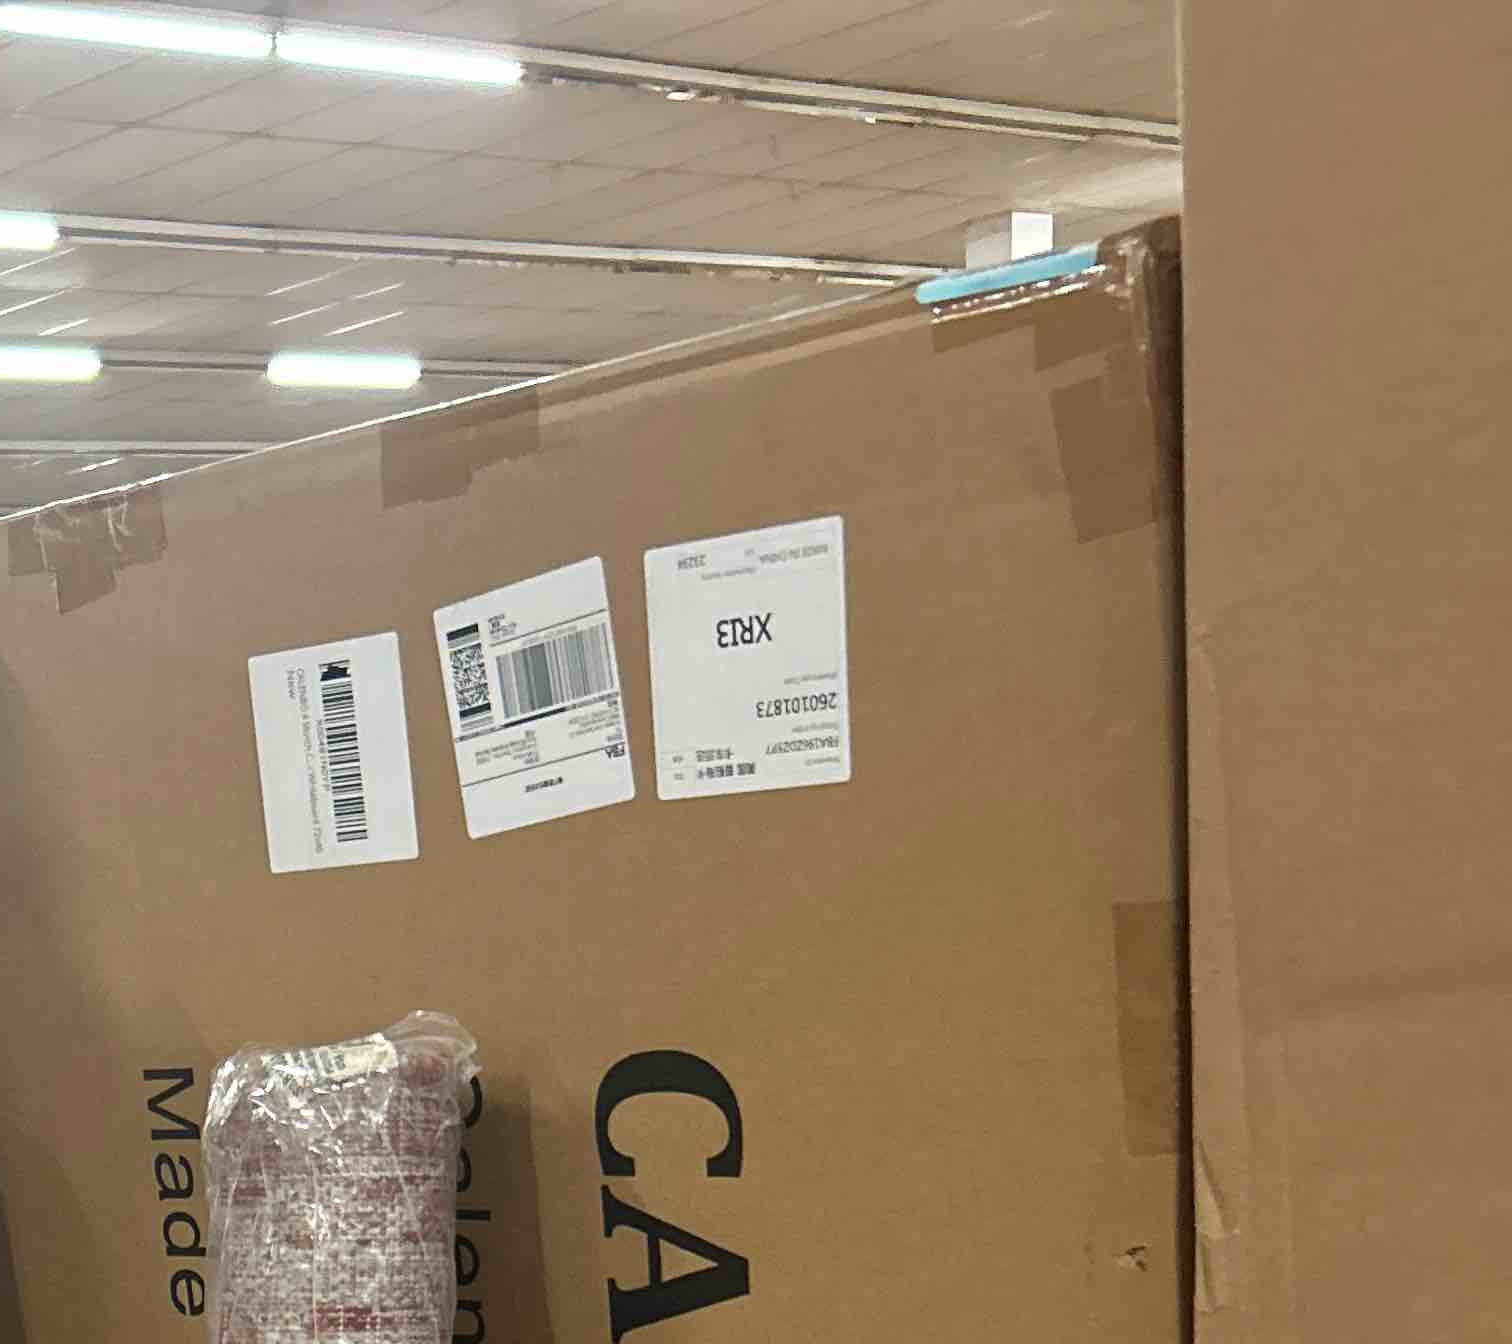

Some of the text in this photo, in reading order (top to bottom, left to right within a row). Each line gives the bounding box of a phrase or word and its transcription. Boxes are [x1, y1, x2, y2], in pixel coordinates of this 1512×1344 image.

[715, 612, 774, 649] XRI3
[756, 691, 839, 719] 260101873
[142, 1066, 208, 1318] Made
